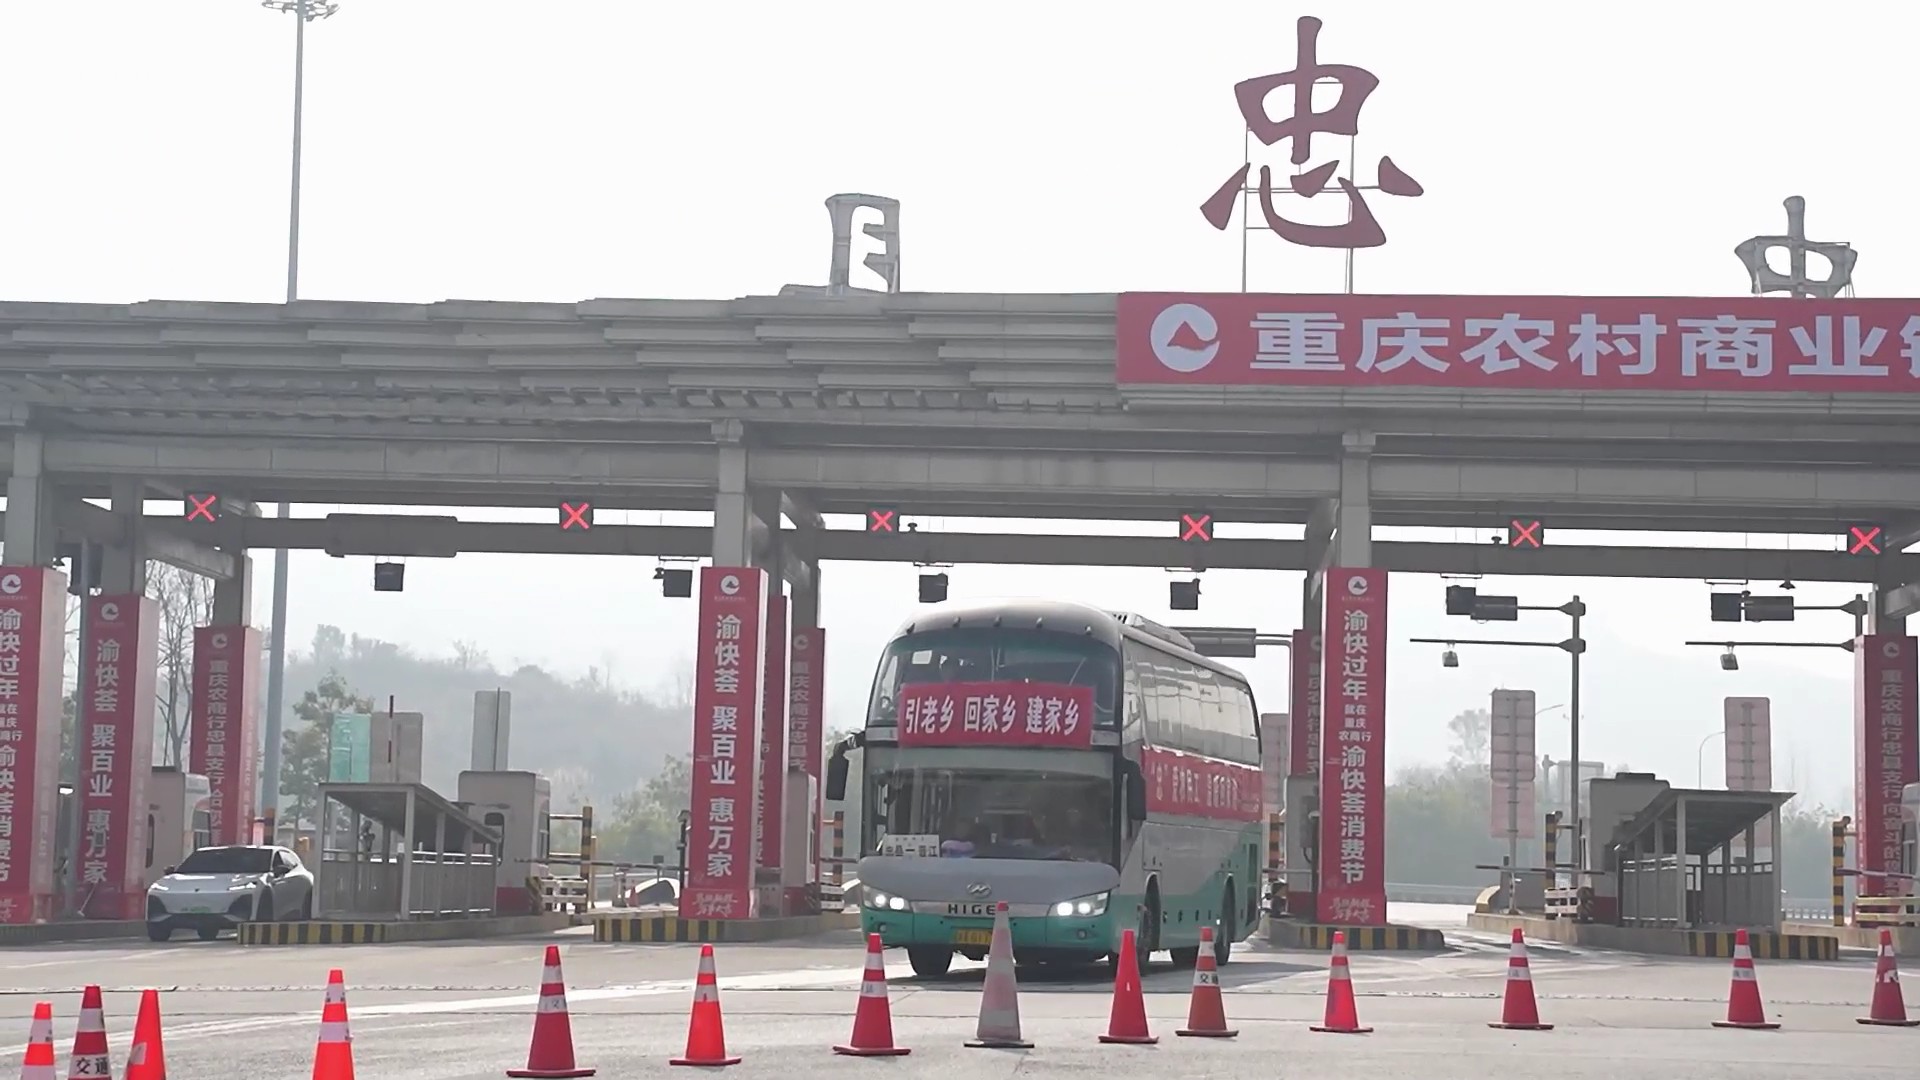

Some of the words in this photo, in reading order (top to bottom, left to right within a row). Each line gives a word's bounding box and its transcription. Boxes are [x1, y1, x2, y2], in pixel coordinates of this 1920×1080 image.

[1201, 16, 1424, 248] 忠
[1248, 312, 1920, 378] 重庆农村商业
[95, 639, 121, 713] 渝快荟
[714, 614, 742, 694] 渝快荟
[1342, 610, 1369, 700] 渝快过年
[710, 705, 738, 785] 聚百业
[904, 696, 954, 735] 引老乡
[964, 694, 1017, 734] 回家乡
[1026, 695, 1080, 736] 建家乡
[1338, 731, 1372, 742] 农商行
[88, 724, 116, 798] 聚百业
[83, 809, 112, 885] 惠万家
[707, 797, 736, 878] 惠万家
[1340, 744, 1367, 884] 渝快荟消费节
[948, 903, 1010, 916] HIGE
[76, 1057, 109, 1075] 交通
